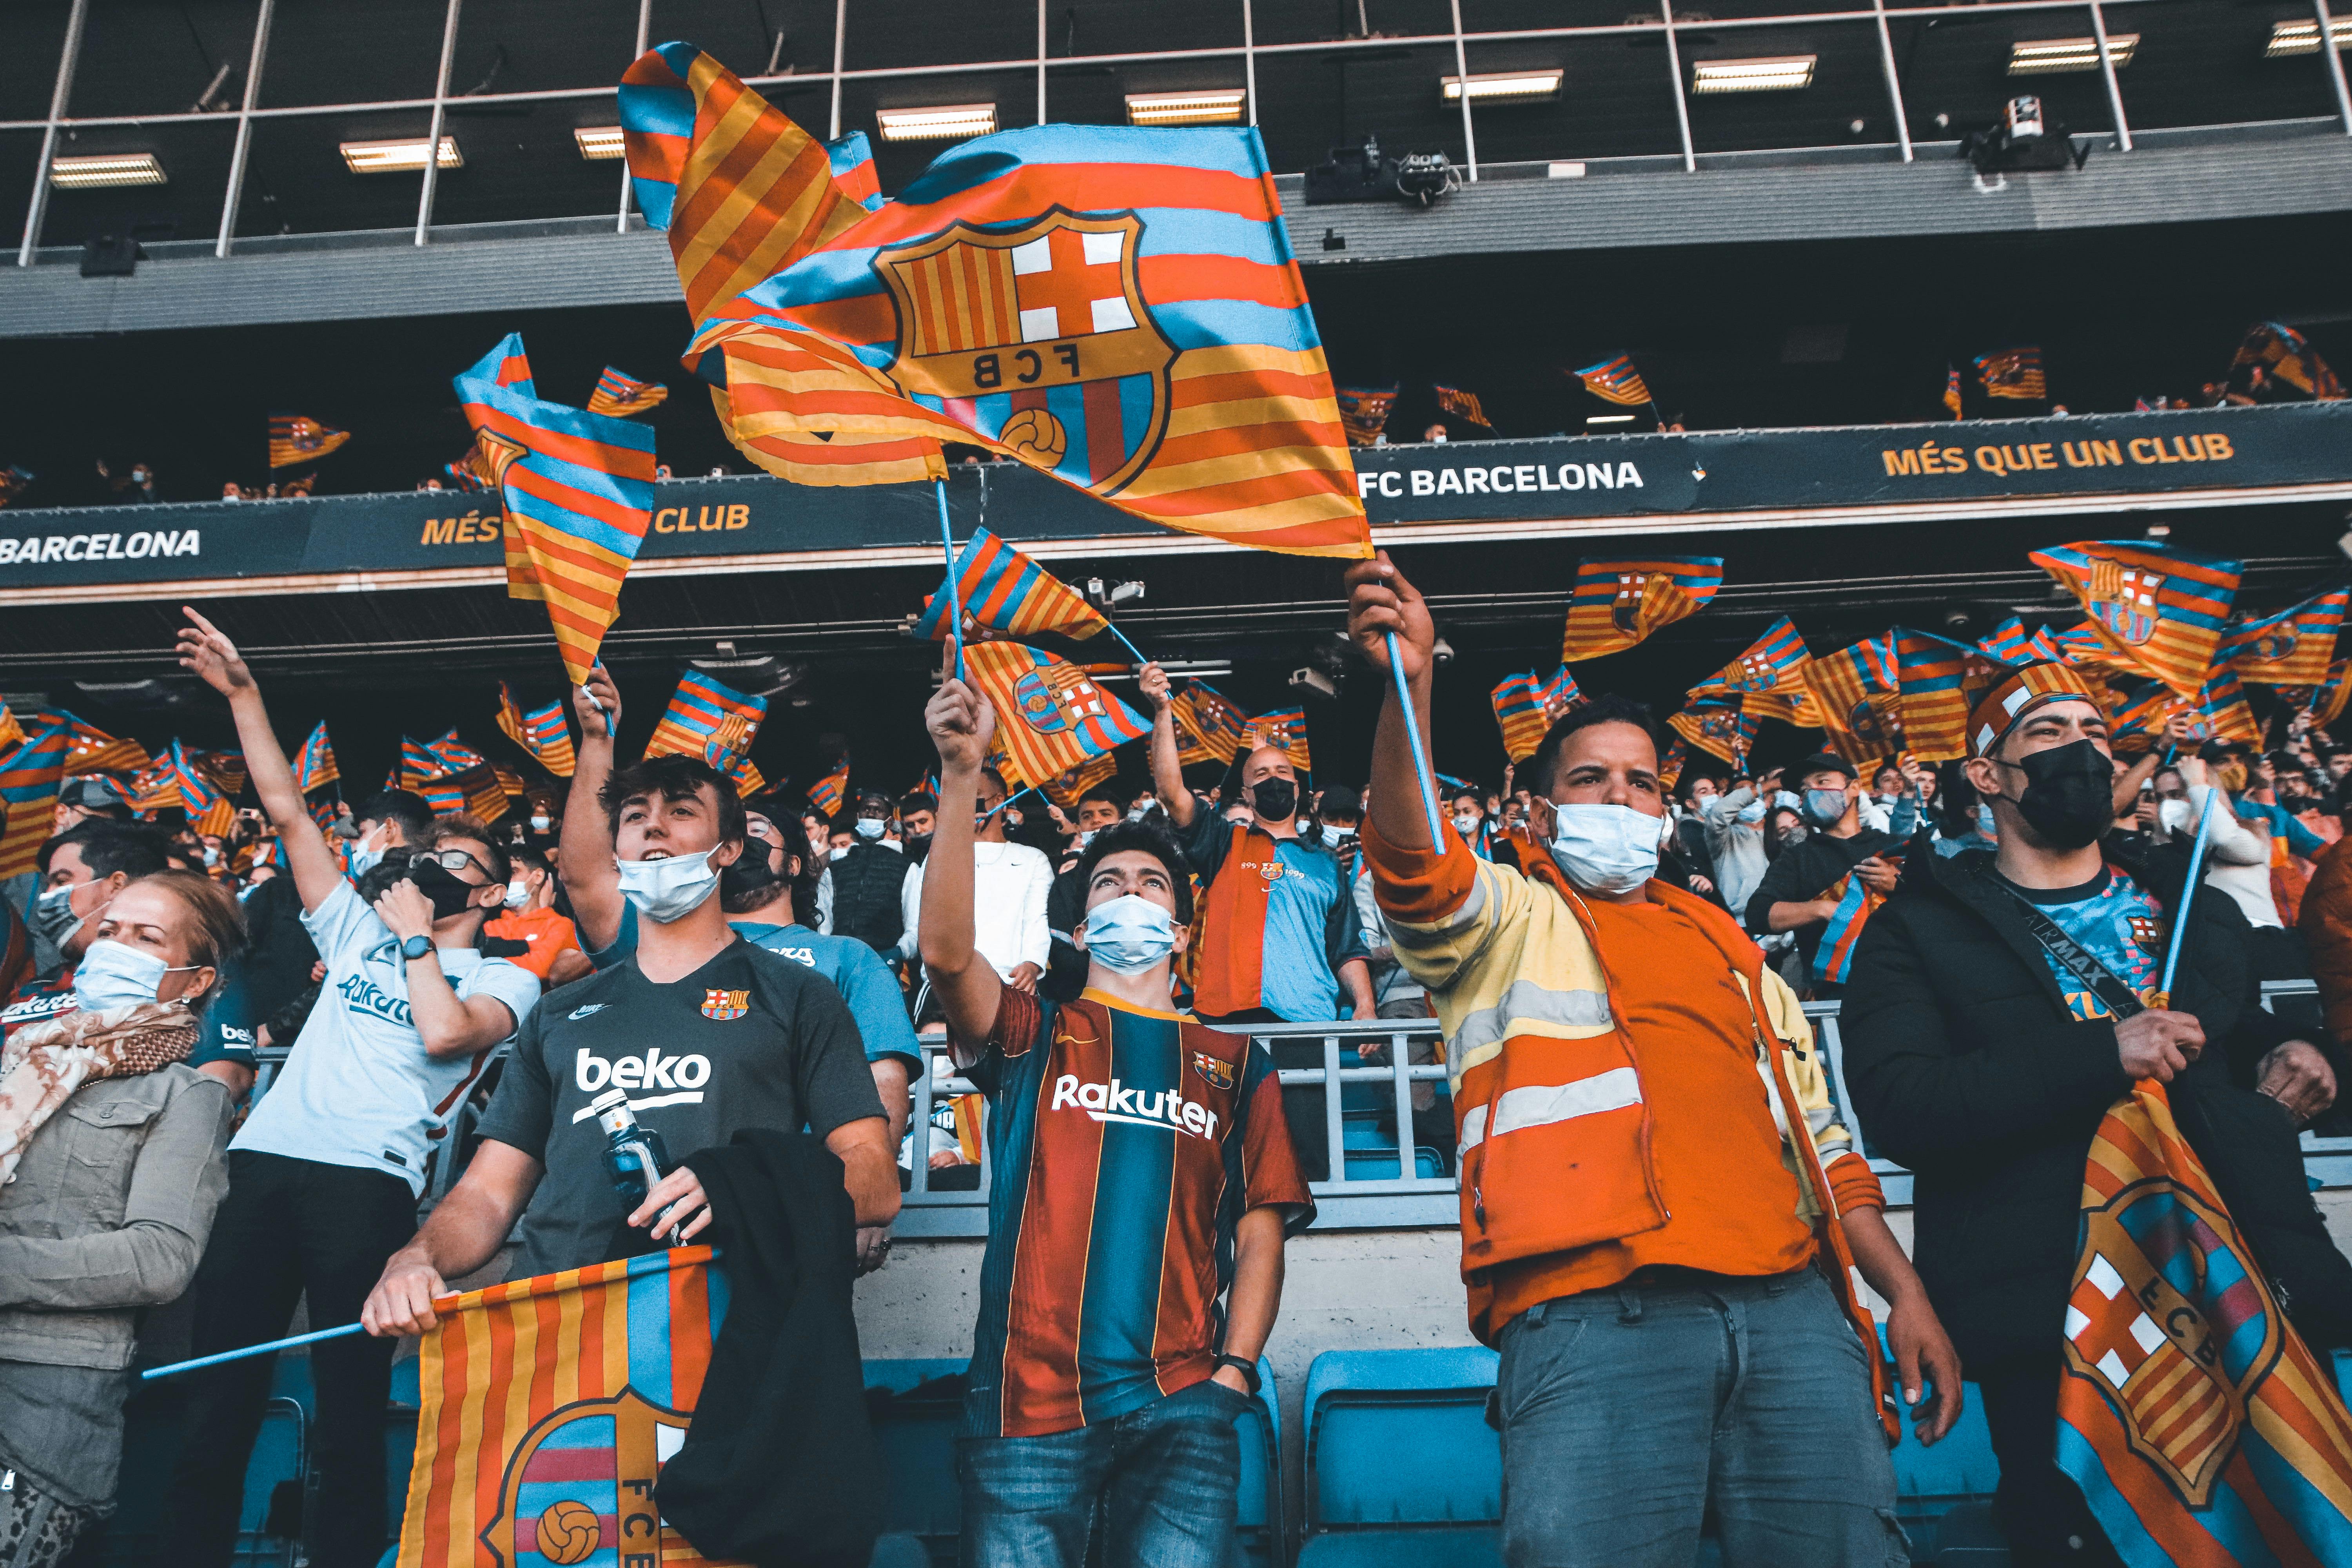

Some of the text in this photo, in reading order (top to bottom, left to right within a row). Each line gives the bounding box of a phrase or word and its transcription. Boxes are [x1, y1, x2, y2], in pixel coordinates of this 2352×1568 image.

[1882, 433, 2234, 477] MÉS QUE UN CLUB
[1357, 461, 1644, 499] FC BARCELONA
[421, 504, 750, 545] MÉS CLUB
[0, 529, 200, 564] BARCELONA
[576, 1003, 605, 1013] NIKE
[576, 1047, 711, 1092] beko
